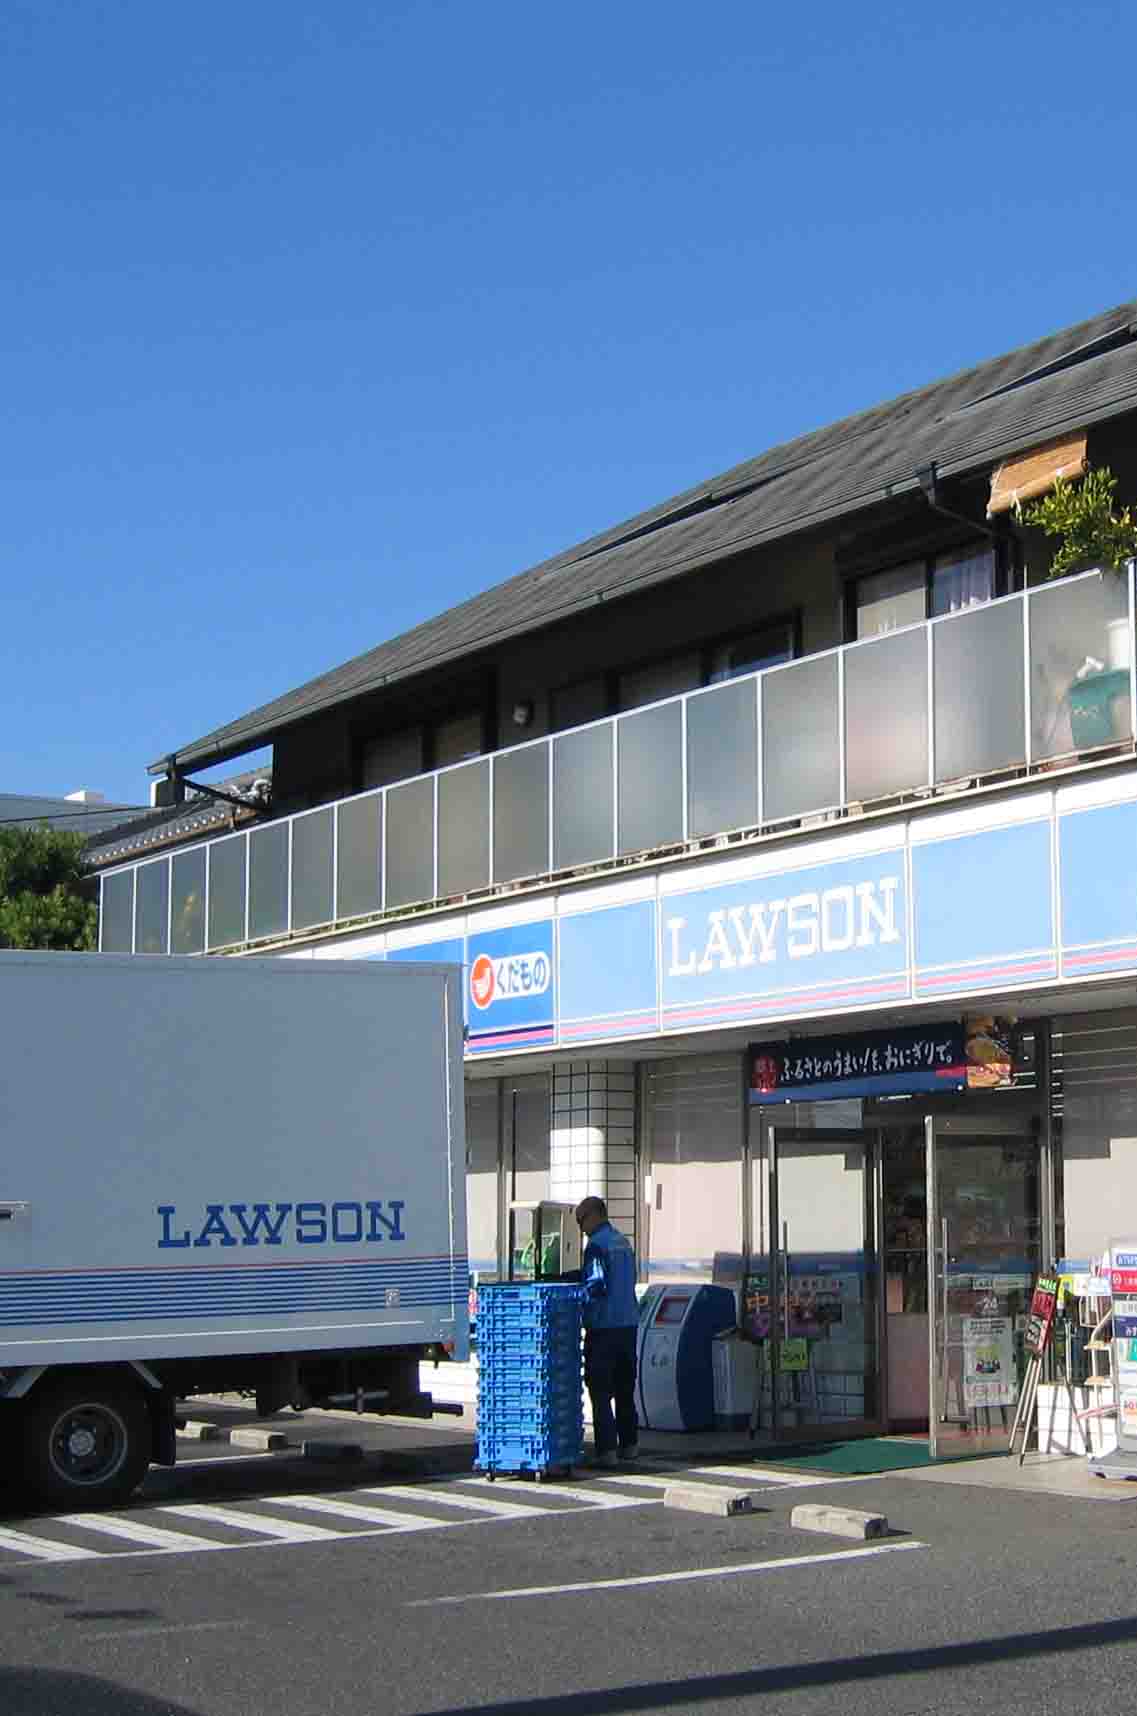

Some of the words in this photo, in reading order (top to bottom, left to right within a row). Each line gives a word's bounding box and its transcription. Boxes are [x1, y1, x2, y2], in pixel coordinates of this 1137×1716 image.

[668, 878, 899, 977] LAWSON
[496, 955, 546, 991] くだもの
[157, 1200, 406, 1249] LAWSON
